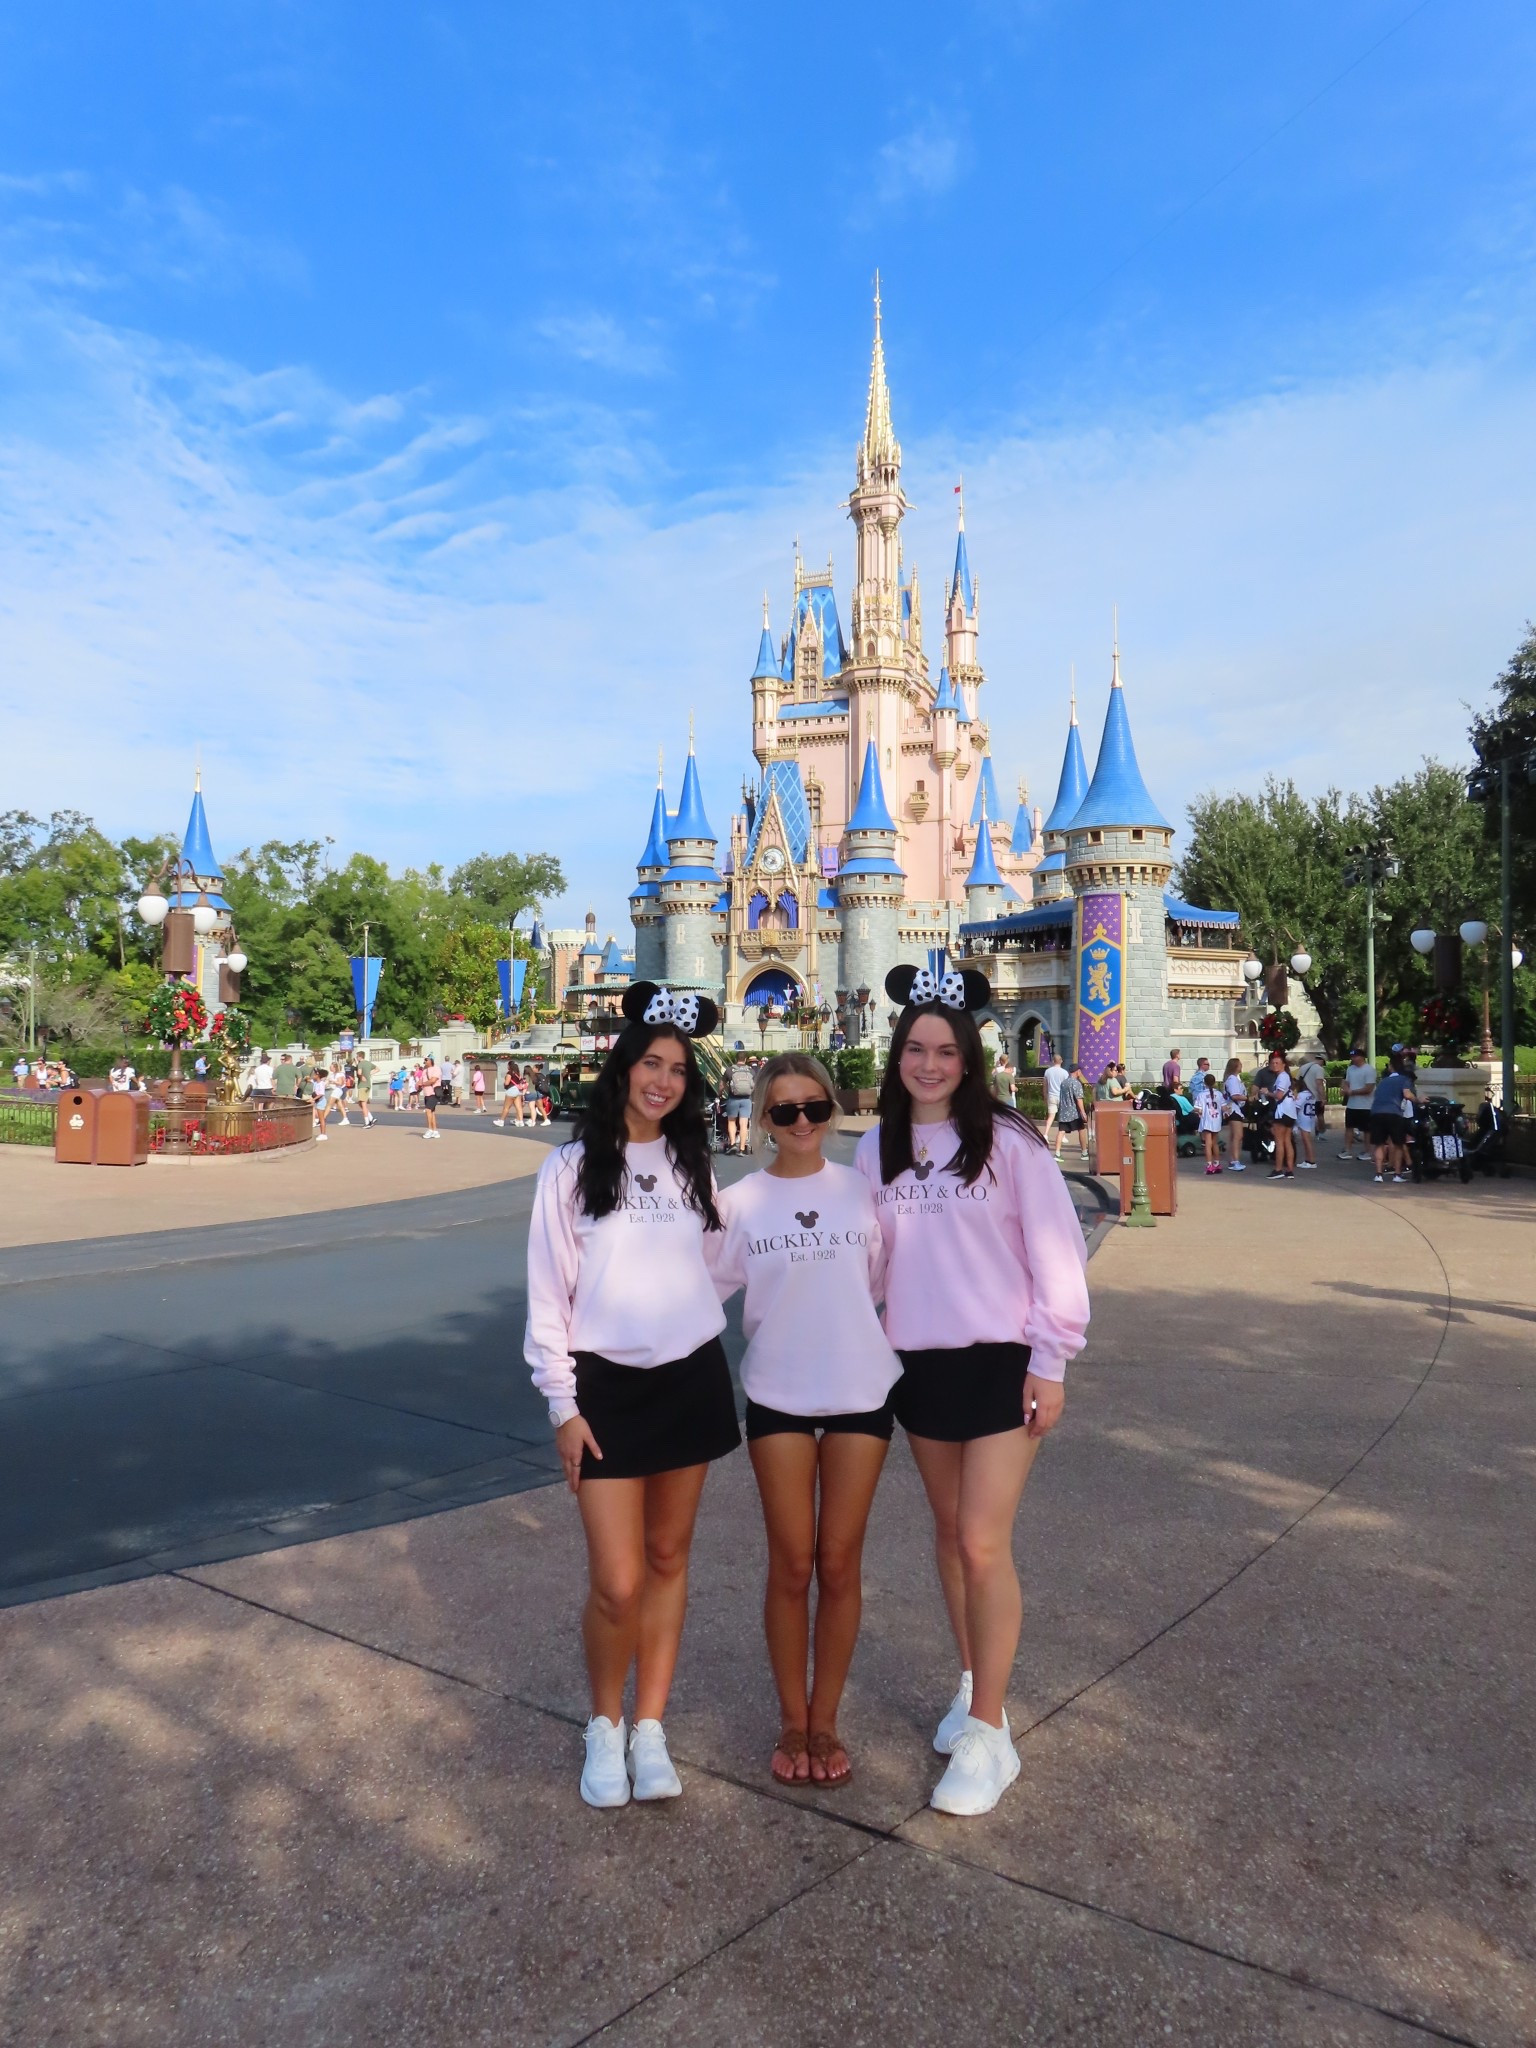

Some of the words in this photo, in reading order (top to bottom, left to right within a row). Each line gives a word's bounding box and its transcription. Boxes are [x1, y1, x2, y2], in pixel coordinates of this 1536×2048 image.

[936, 1186, 949, 1199] &
[955, 1183, 990, 1202] CO.
[667, 1197, 679, 1210] &
[897, 1204, 915, 1215] Est.
[919, 1203, 943, 1214] 1928
[629, 1213, 648, 1223] Est.
[651, 1213, 676, 1223] 1928
[747, 1231, 825, 1257] MICKEY
[829, 1232, 842, 1246] &
[790, 1252, 808, 1263] Est.
[812, 1250, 836, 1261] 1928
